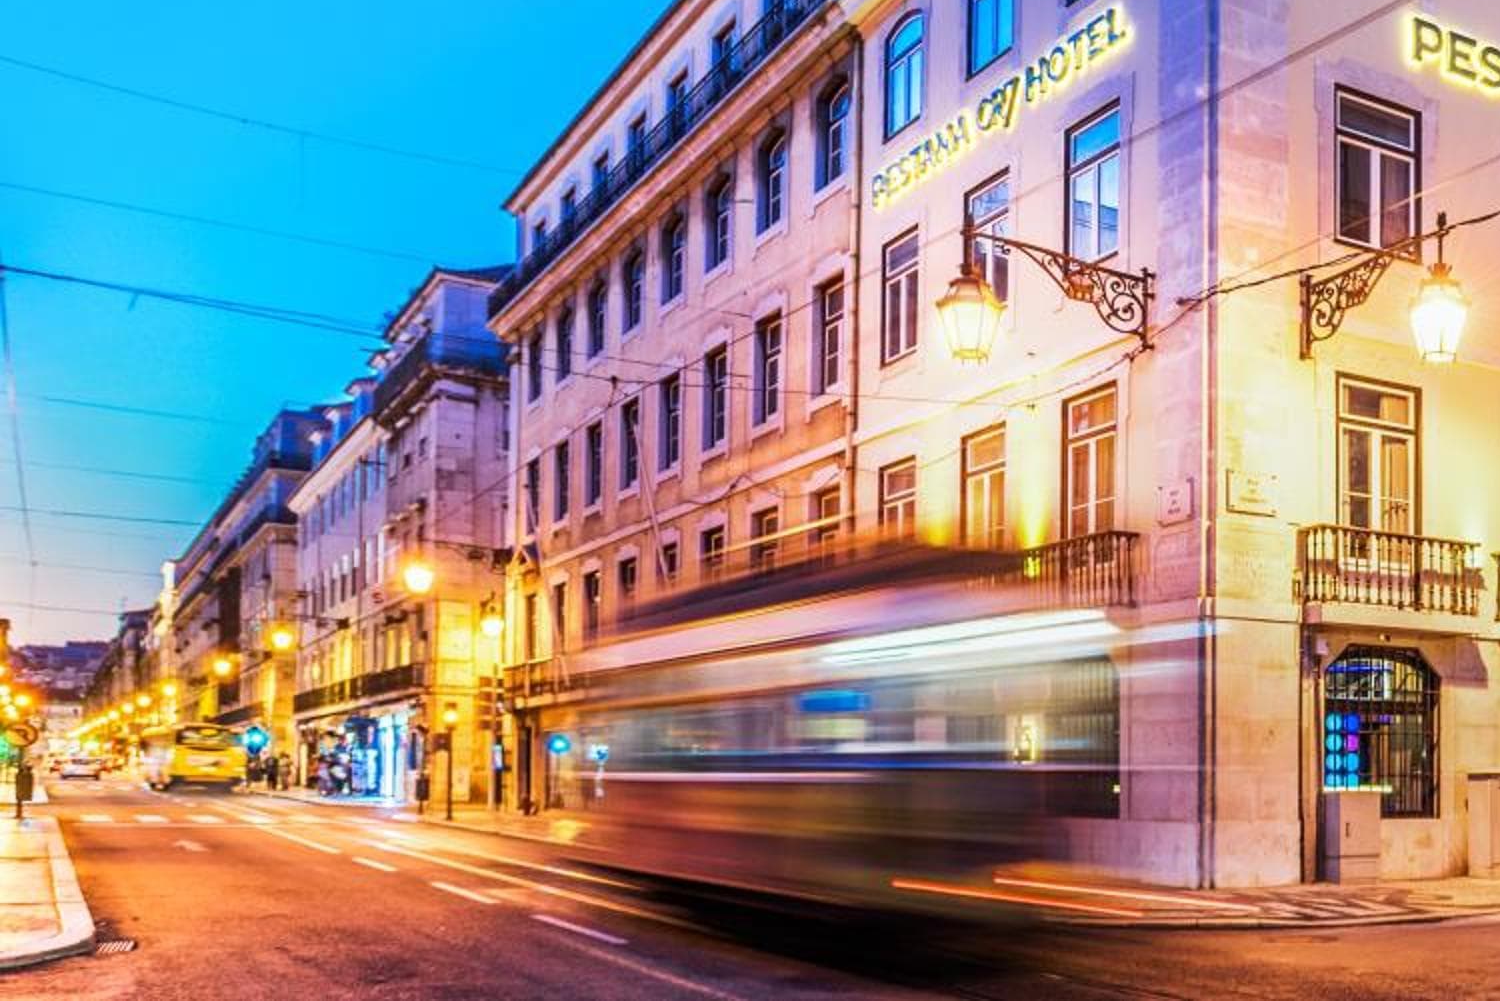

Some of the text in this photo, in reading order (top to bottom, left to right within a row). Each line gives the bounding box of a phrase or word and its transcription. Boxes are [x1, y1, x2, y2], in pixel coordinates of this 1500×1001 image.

[871, 8, 1125, 207] PESTANA CR7 HOTEL
